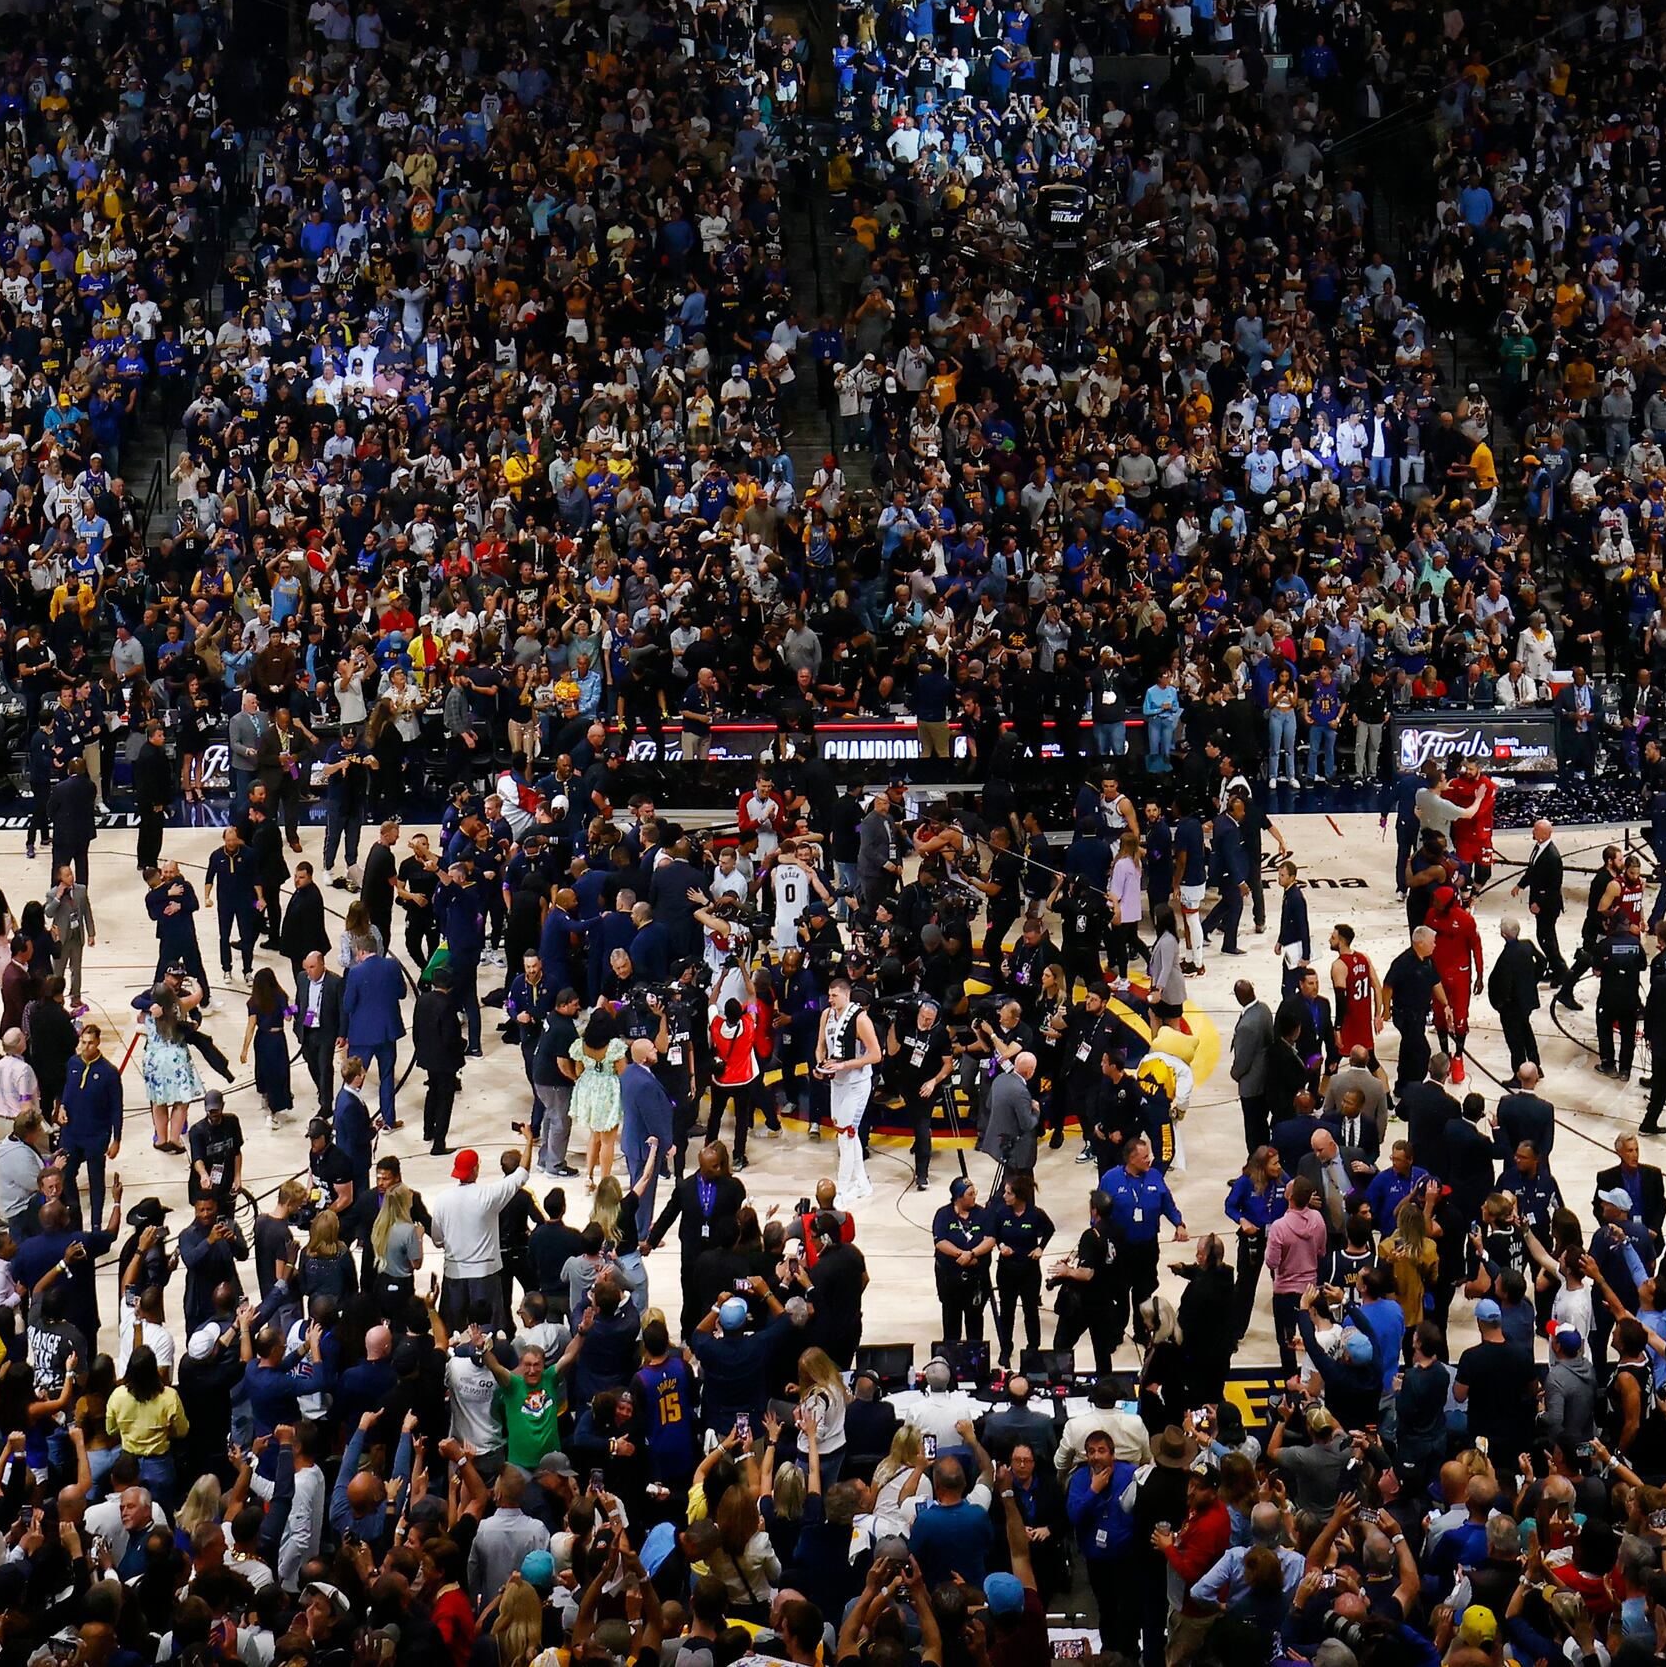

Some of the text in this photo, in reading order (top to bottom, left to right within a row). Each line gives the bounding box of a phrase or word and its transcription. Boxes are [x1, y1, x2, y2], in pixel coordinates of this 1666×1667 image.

[1050, 213, 1084, 223] WILDCAT
[785, 883, 795, 902] 0
[1261, 877, 1369, 892] rena
[1612, 943, 1640, 955] ESPN
[1354, 977, 1369, 1001] 31
[1161, 1122, 1175, 1165] NUGGETS
[657, 1392, 682, 1426] 15
